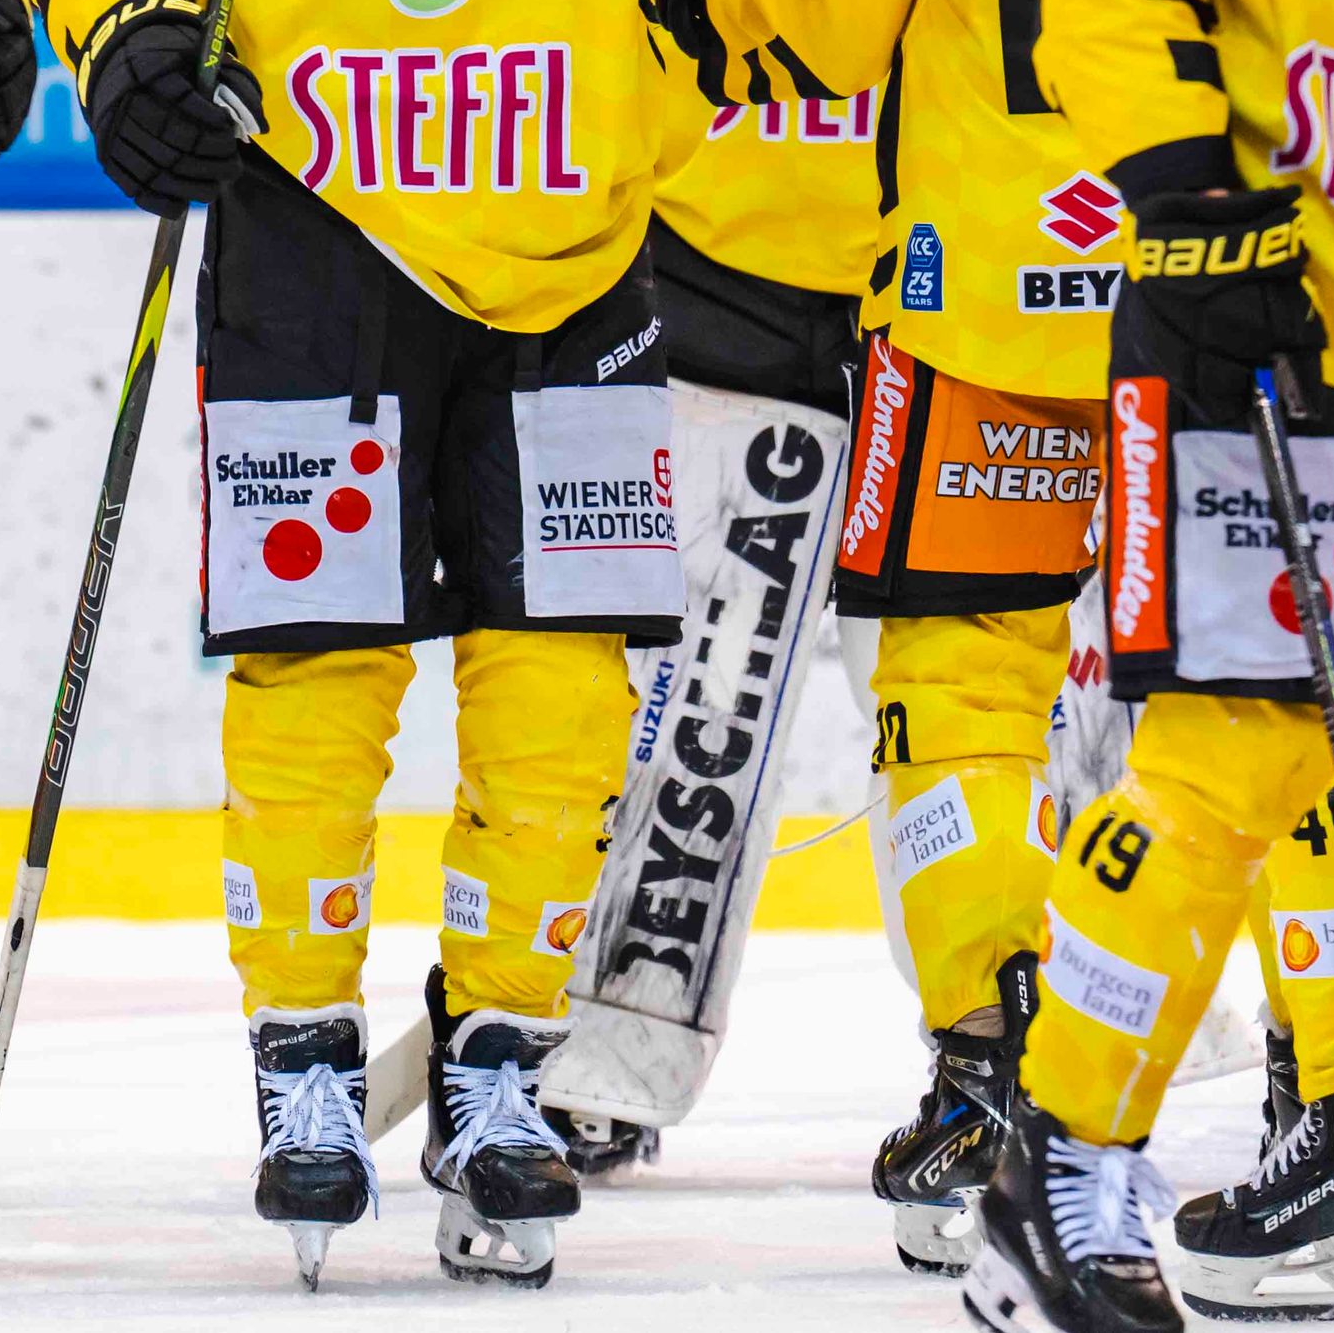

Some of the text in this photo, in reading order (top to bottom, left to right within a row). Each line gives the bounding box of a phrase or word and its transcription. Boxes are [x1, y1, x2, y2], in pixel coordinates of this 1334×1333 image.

[289, 47, 585, 194] STEFFL
[910, 236, 935, 256] ICE
[905, 296, 934, 307] YEARS
[906, 270, 935, 296] 25
[977, 421, 1092, 461] WIEN
[216, 450, 337, 483] Schuller
[935, 463, 1101, 502] ENERGIE
[537, 480, 654, 509] WIENER
[635, 660, 675, 764] SUZUKI
[910, 820, 964, 865] land
[1078, 811, 1152, 894] 19
[1016, 969, 1030, 1016] CCM
[1056, 939, 1154, 1006] burgen
[1080, 981, 1147, 1030] land
[921, 1125, 985, 1187] CCM
